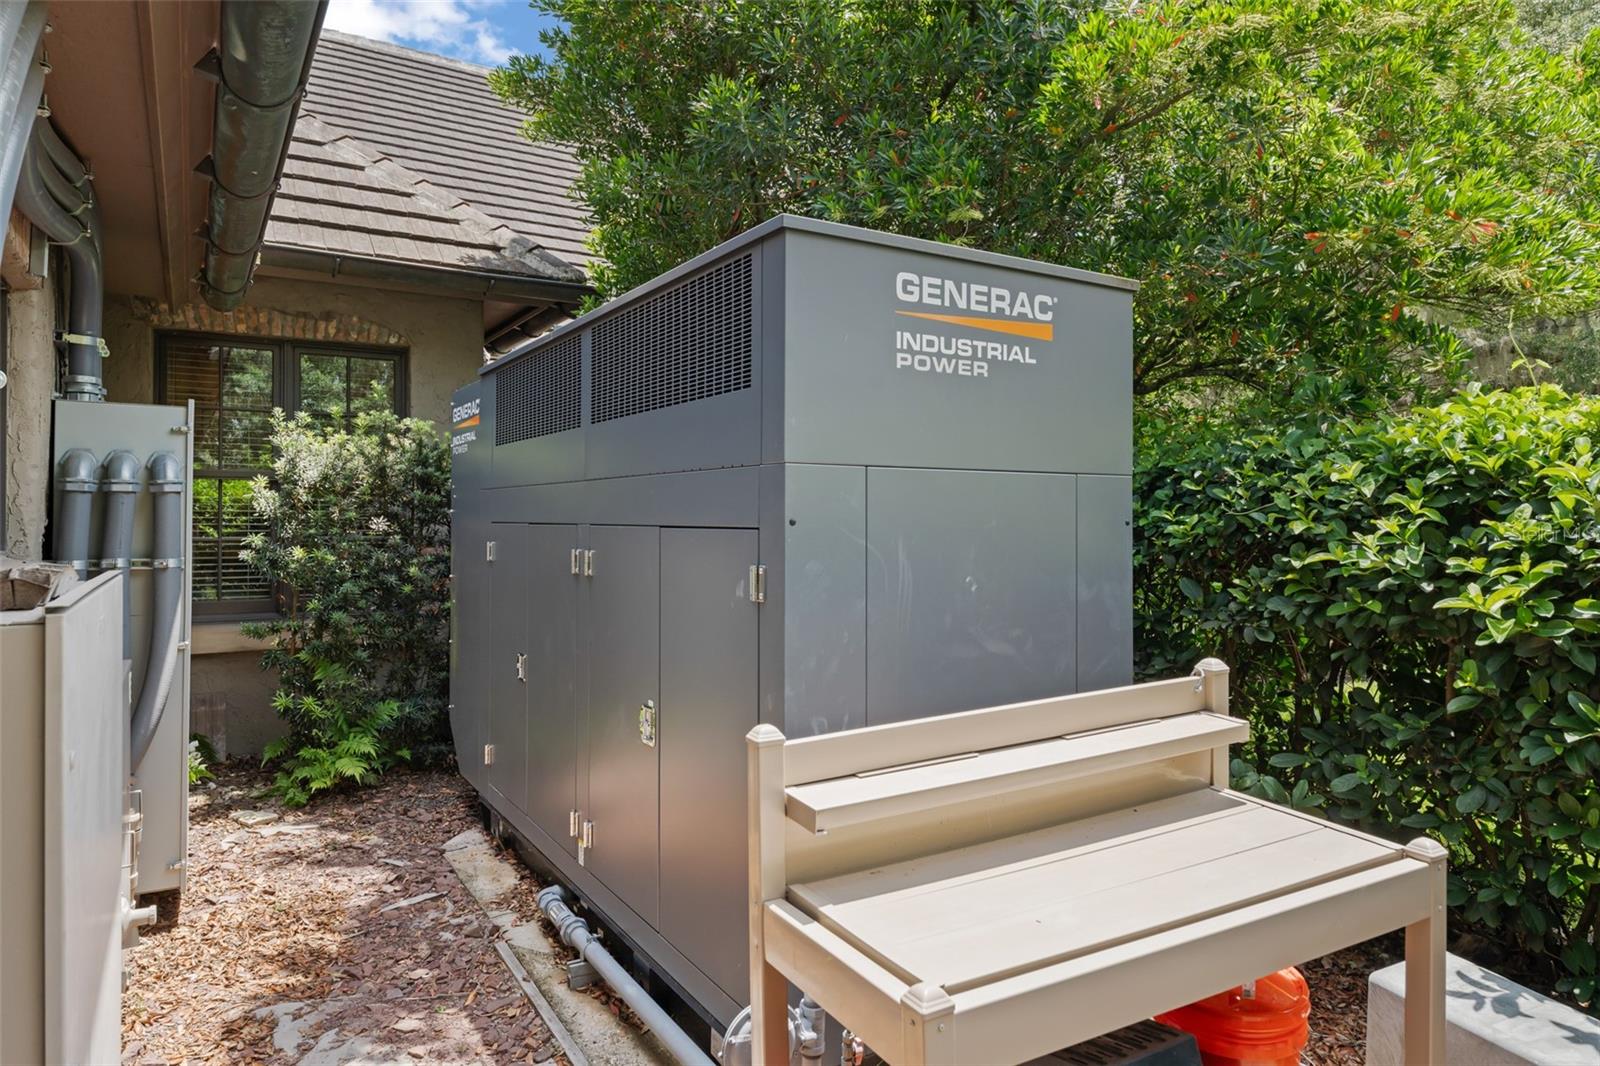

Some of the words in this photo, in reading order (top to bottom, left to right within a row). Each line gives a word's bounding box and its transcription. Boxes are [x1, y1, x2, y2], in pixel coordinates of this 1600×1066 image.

[896, 272, 1053, 321] GENERAC
[896, 331, 1037, 364] INDUSTRIAL
[896, 353, 988, 377] POWER
[453, 398, 480, 422] GENERAC
